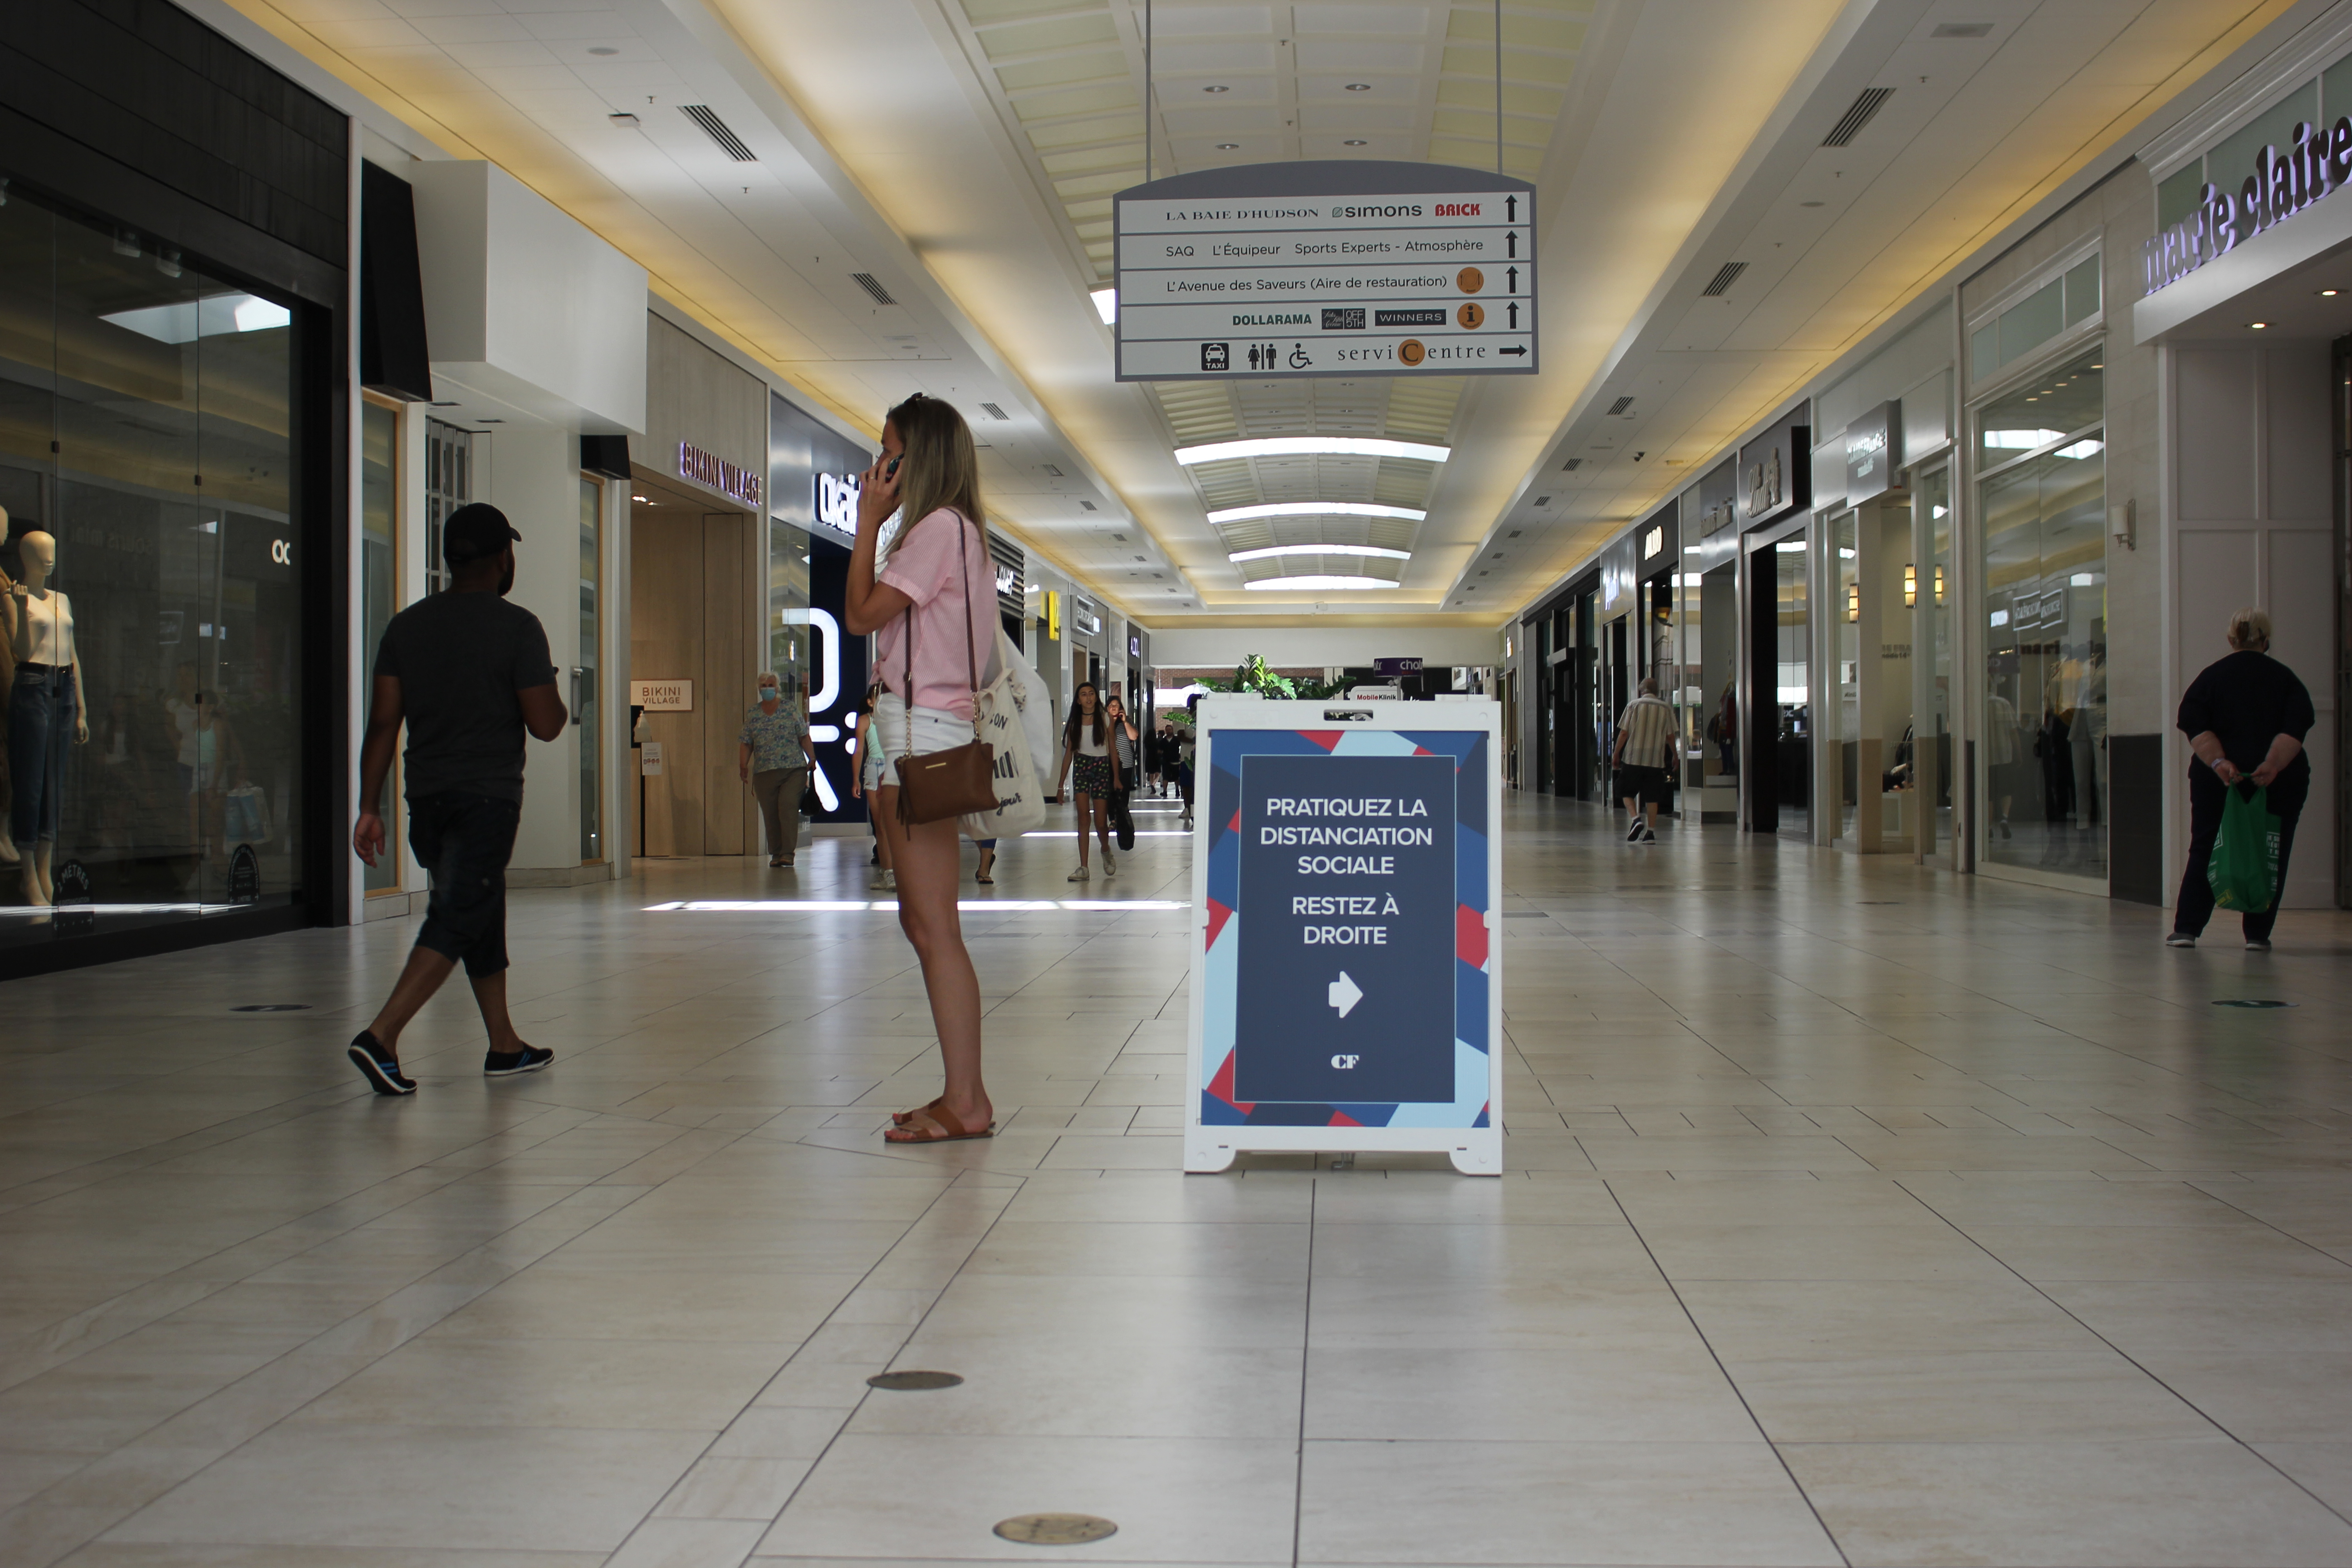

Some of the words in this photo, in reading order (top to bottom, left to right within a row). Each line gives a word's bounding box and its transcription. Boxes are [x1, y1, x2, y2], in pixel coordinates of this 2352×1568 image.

[1345, 205, 1422, 218] simons
[1435, 203, 1481, 217] BRICK
[2140, 182, 2235, 295] marie
[2239, 116, 2352, 238] claire
[1166, 211, 1187, 221] LA
[1192, 210, 1231, 220] BAIE
[1237, 208, 1318, 219] D'HUDSON
[1166, 245, 1194, 257] SAQ
[1213, 242, 1281, 257] L'Équipeur
[1295, 243, 1337, 256] Sports
[1342, 242, 1391, 255] Experts
[1405, 239, 1483, 253] Atmosphère
[1230, 280, 1252, 291] des
[1256, 279, 1306, 290] Saveurs
[1310, 278, 1341, 290] (Aire
[1346, 277, 1362, 288] de
[1367, 276, 1447, 288] restauration)
[1232, 314, 1312, 326] DOLLARAMA
[1346, 310, 1363, 319] OFF
[1380, 313, 1442, 322] WINNERS
[1346, 318, 1364, 328] 5TH
[683, 442, 721, 488] BIKINI
[721, 460, 762, 505] VILLAGE
[1644, 525, 1663, 561] ALDO
[642, 686, 680, 696] BIKINI
[1267, 798, 1392, 818] PRATIQUEZ
[1399, 799, 1427, 817] LA
[1260, 827, 1433, 846] DISTANCIATION
[1298, 855, 1394, 875] SOCIALE
[1293, 897, 1377, 916] RESTEZ
[1382, 892, 1400, 915] À
[1303, 926, 1387, 945] DROITE
[1331, 1054, 1359, 1069] CF
